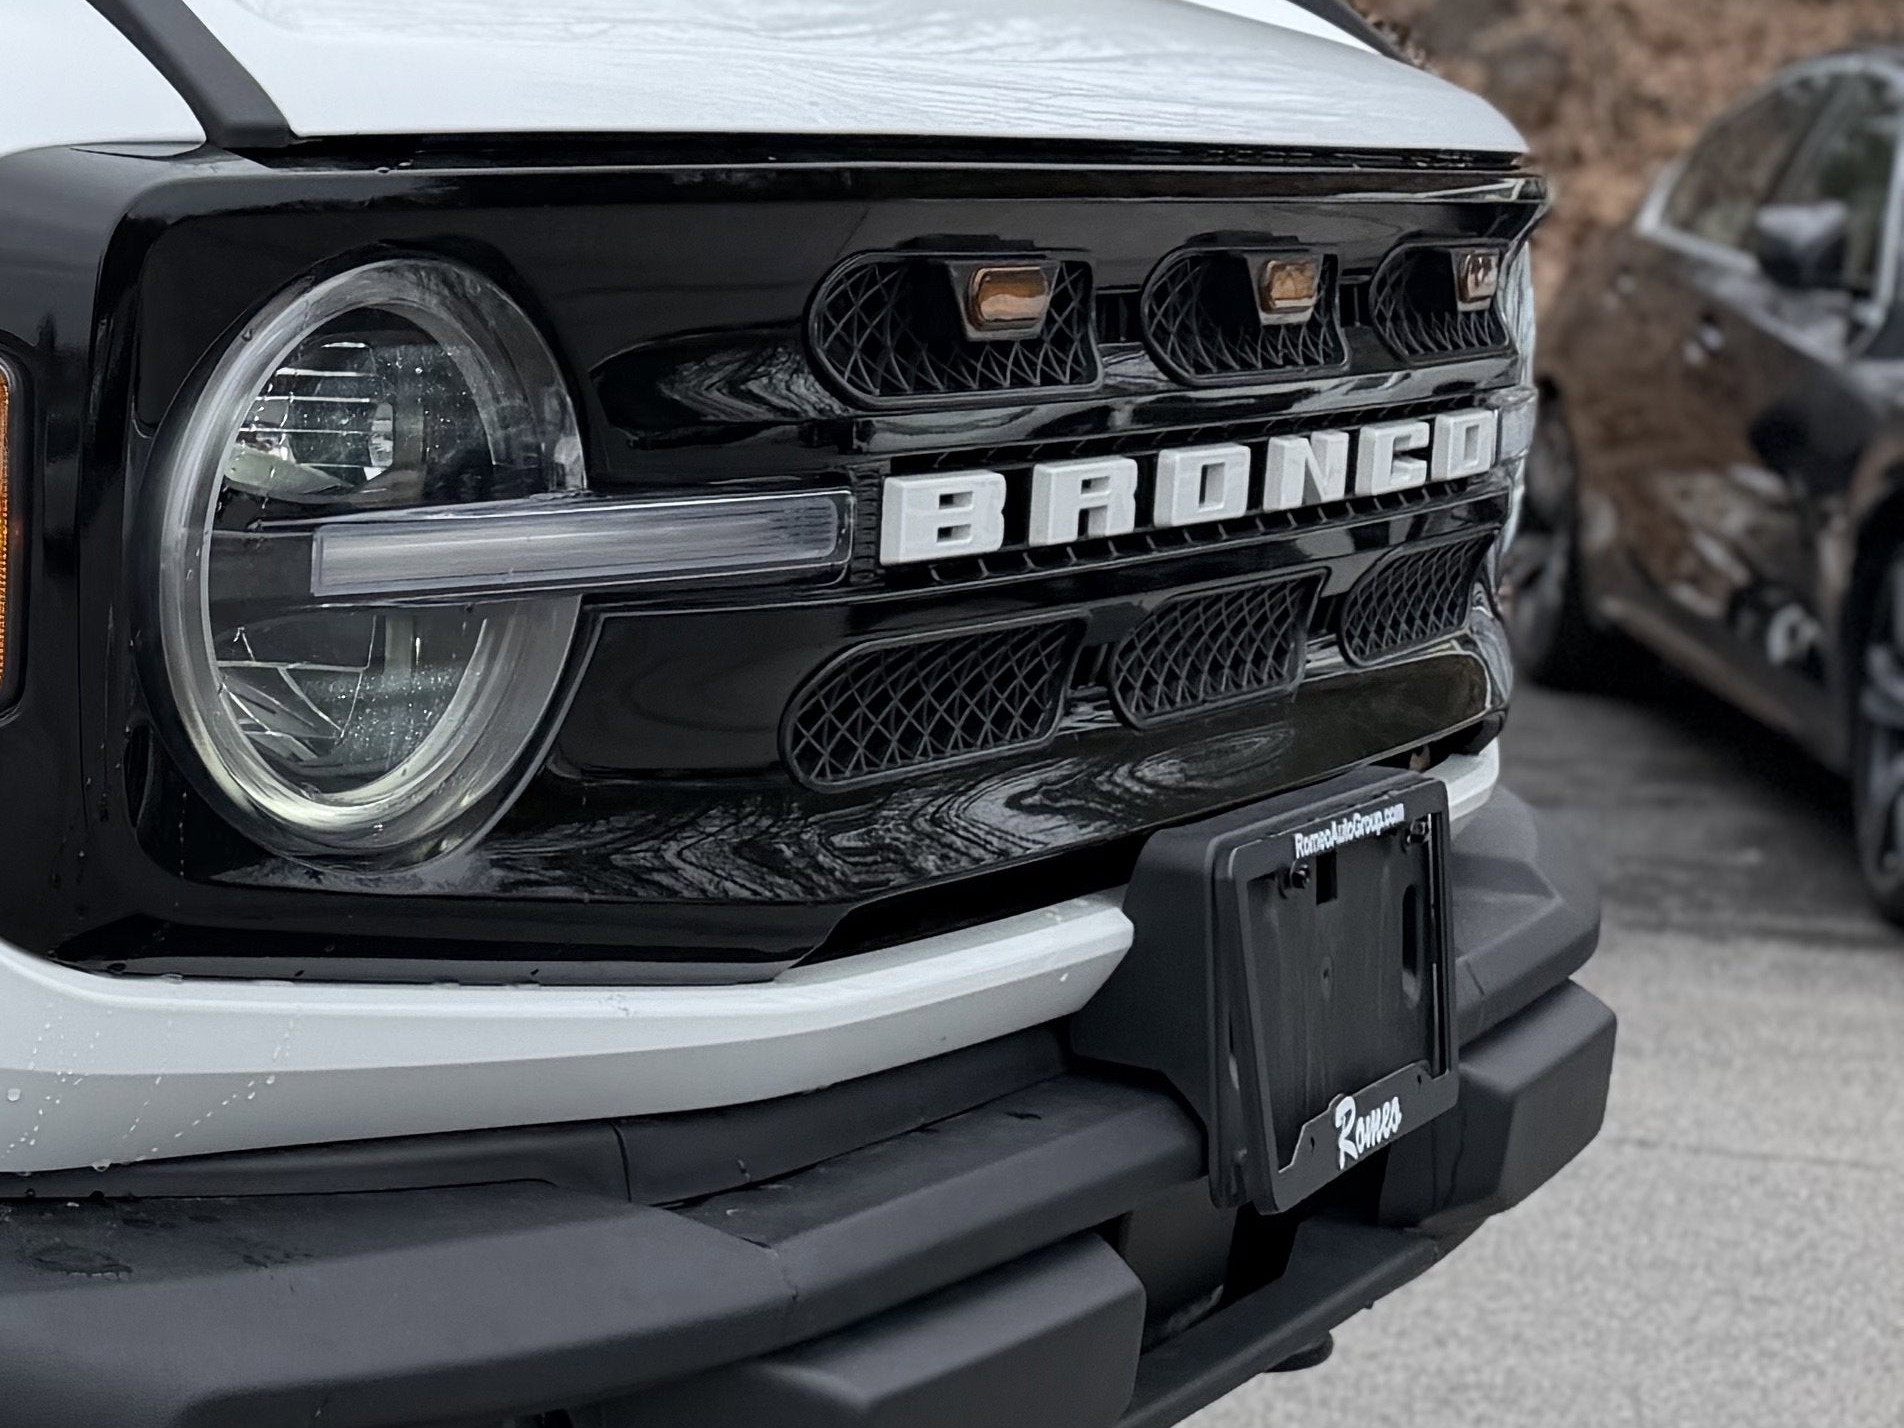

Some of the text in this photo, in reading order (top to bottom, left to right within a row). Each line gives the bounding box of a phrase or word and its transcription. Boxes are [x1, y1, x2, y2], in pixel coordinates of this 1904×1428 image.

[879, 407, 1498, 567] BRONCO
[1294, 802, 1405, 860] RomeoAutoGroup.com
[1334, 1094, 1402, 1170] Romeo
